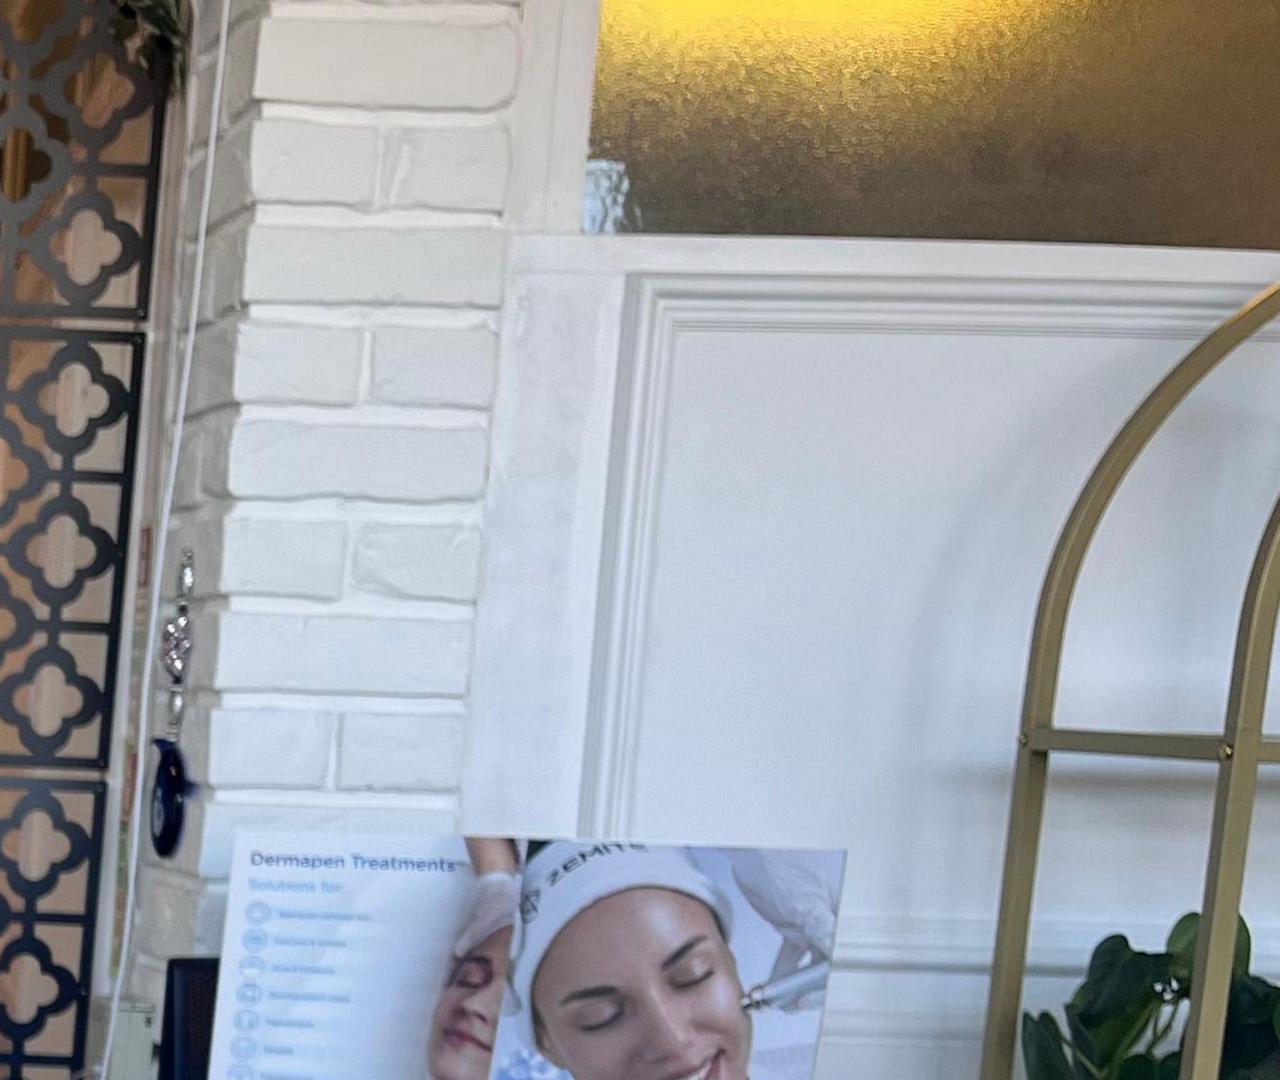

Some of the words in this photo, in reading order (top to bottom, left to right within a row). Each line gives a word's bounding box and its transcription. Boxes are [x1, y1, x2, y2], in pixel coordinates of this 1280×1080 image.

[250, 852, 345, 871] Dermapen
[351, 854, 457, 873] Treatments
[248, 878, 316, 894] Solutions
